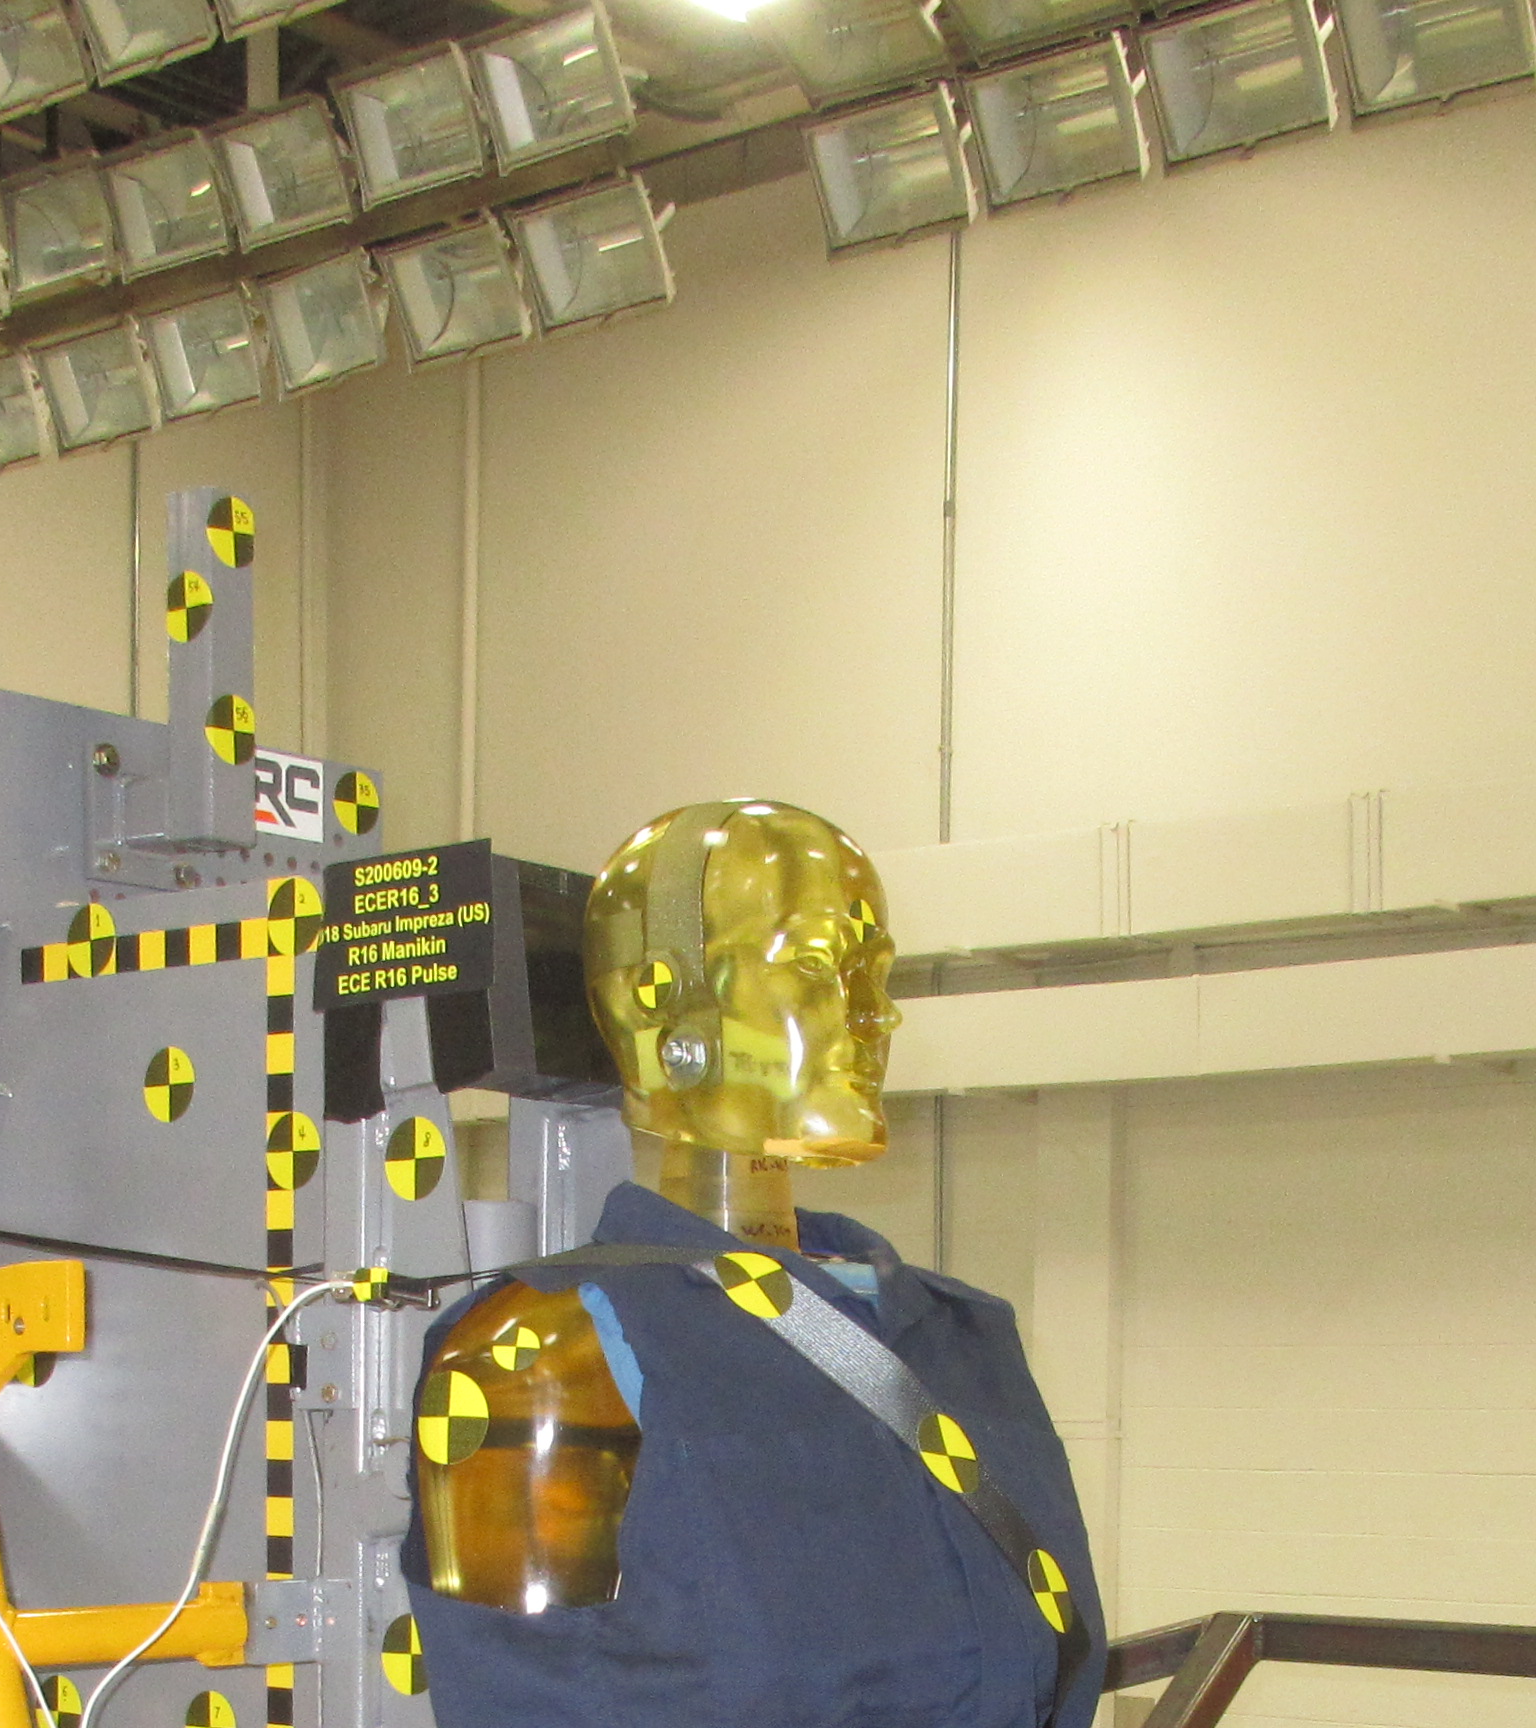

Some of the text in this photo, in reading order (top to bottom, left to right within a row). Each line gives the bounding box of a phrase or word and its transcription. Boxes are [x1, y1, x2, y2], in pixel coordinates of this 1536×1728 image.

[255, 757, 320, 828] RC
[354, 856, 439, 887] S200609-2
[354, 883, 440, 915] ECER16_3
[343, 919, 392, 941] Subaru
[395, 911, 455, 936] Impreza
[457, 902, 492, 928] (US)
[348, 936, 447, 967] R16 Manikin
[337, 962, 458, 995] ECE R16 Pulse
